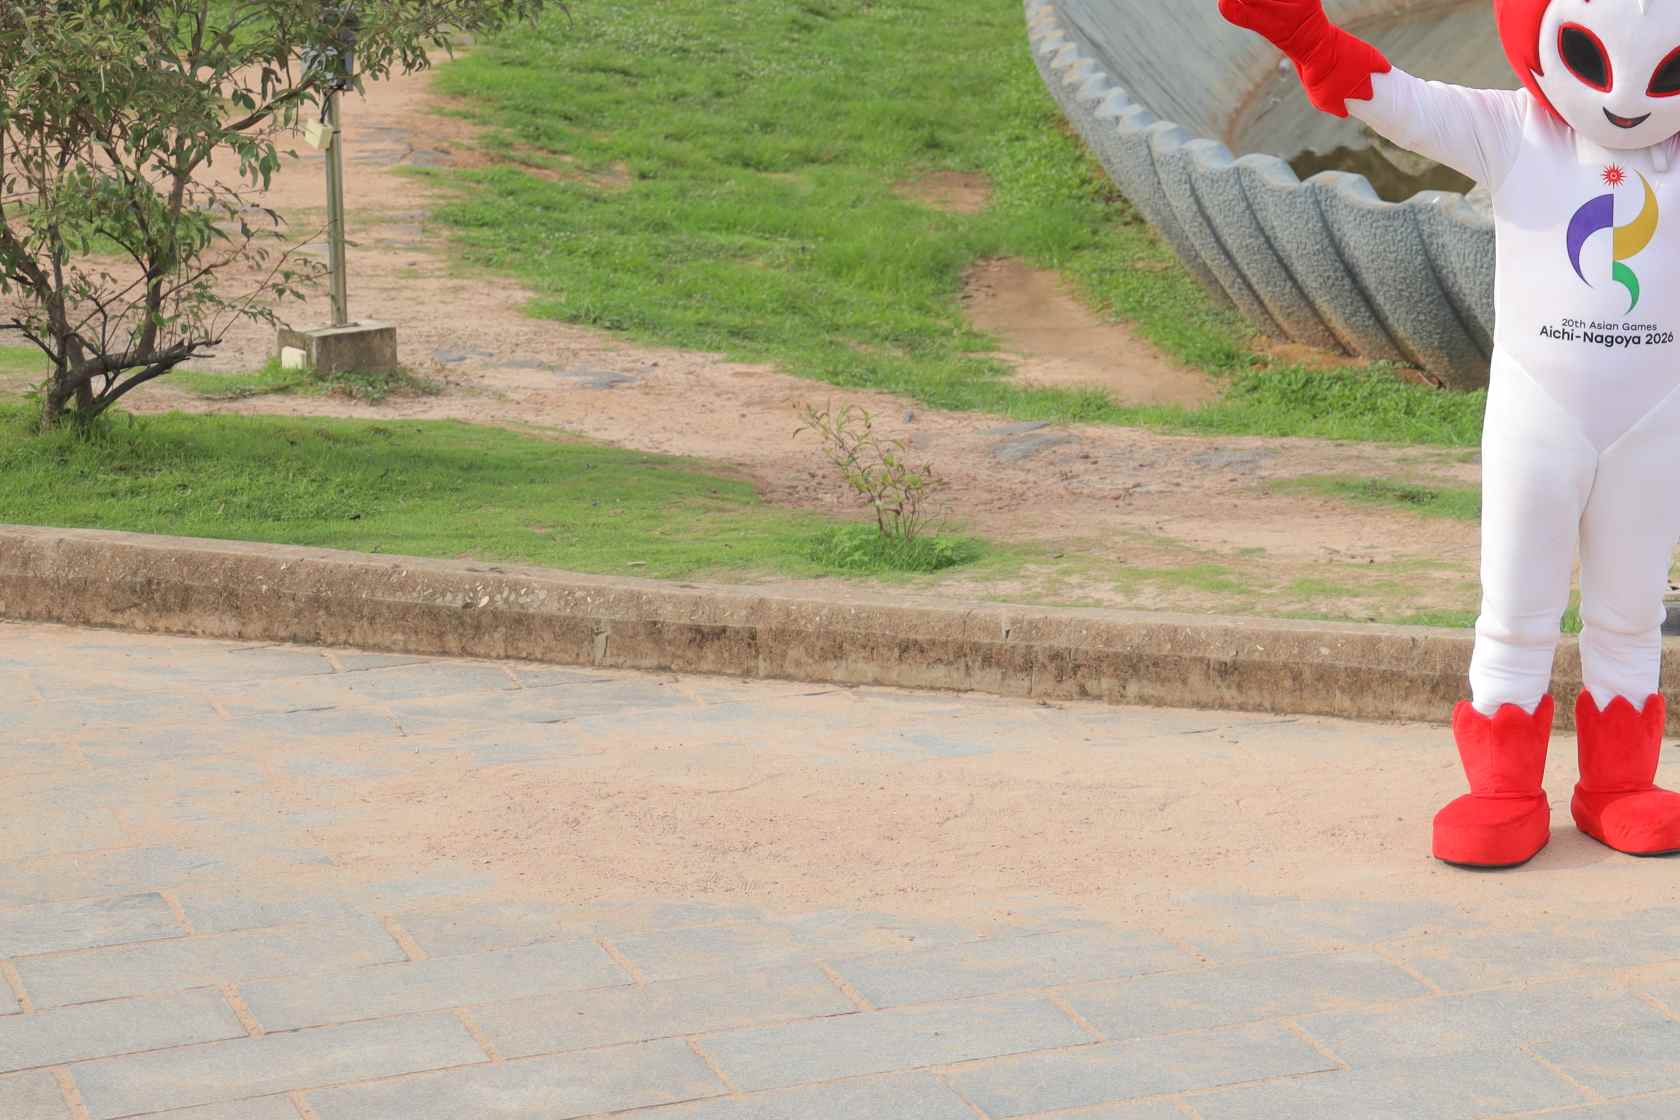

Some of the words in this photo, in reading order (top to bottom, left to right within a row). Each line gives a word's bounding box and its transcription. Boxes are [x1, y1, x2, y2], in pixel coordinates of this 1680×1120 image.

[1561, 318, 1586, 329] 20th
[1589, 320, 1619, 331] Asian
[1622, 322, 1658, 331] Games
[1539, 325, 1642, 348] Aichi-Nagoya
[1645, 331, 1674, 345] 2026
